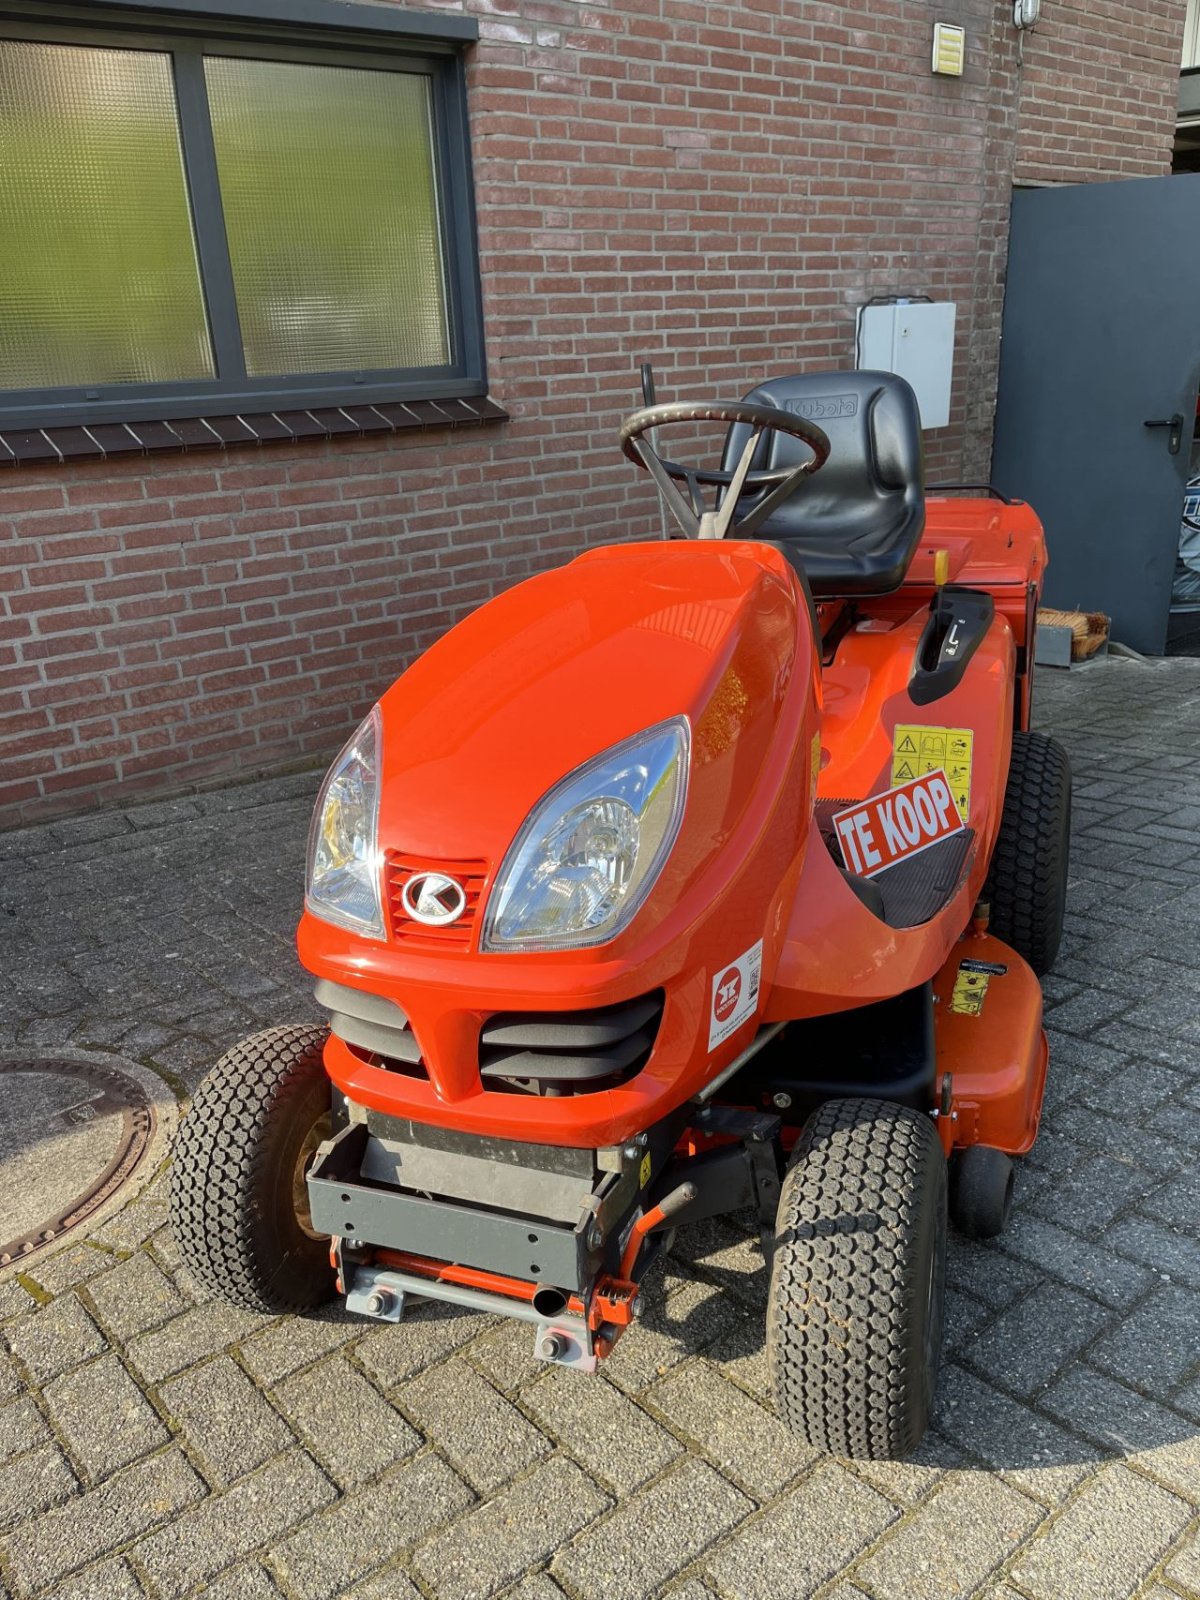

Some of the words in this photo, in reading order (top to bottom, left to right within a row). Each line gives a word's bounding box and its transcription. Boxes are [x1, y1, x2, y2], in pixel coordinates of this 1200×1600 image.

[786, 398, 856, 417] Kubota
[838, 810, 882, 874] TE
[876, 778, 950, 856] KOOP
